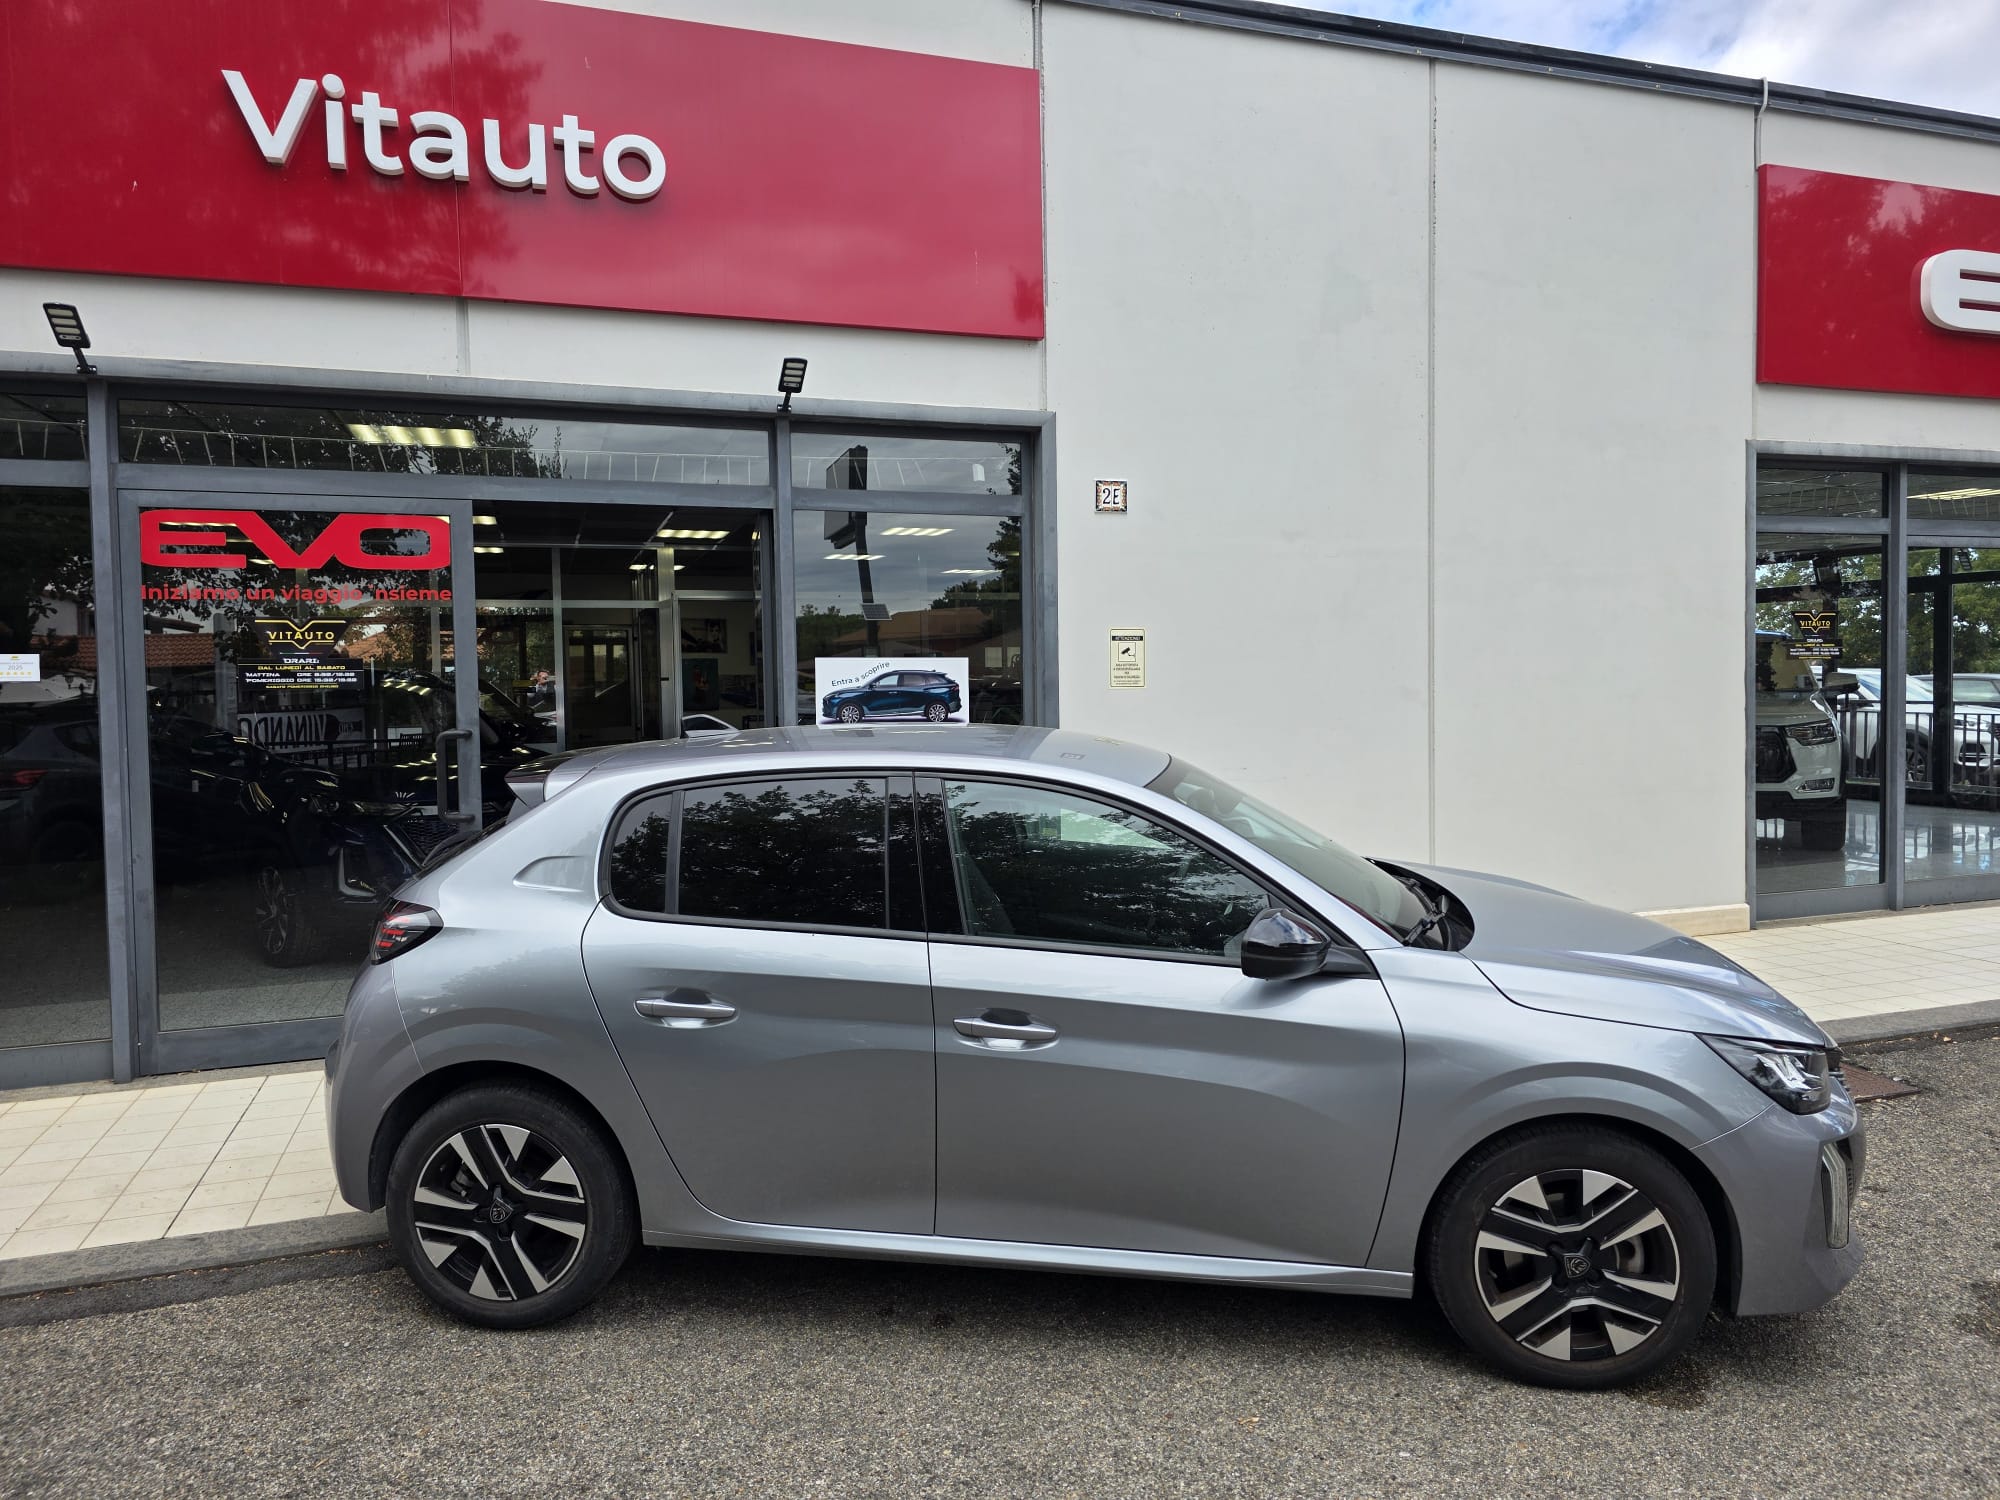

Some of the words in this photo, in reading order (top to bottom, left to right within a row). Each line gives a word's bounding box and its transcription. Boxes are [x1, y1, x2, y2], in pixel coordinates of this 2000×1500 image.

[221, 69, 666, 200] Vitauto
[1102, 487, 1120, 505] 2E
[139, 509, 451, 570] EVO
[141, 584, 239, 601] Iniziamo
[246, 588, 275, 601] un
[281, 584, 362, 604] viaggio
[368, 584, 452, 601] nsieme
[268, 631, 335, 640] VITAUTO
[831, 678, 853, 687] Entra
[861, 662, 890, 680] scoprire
